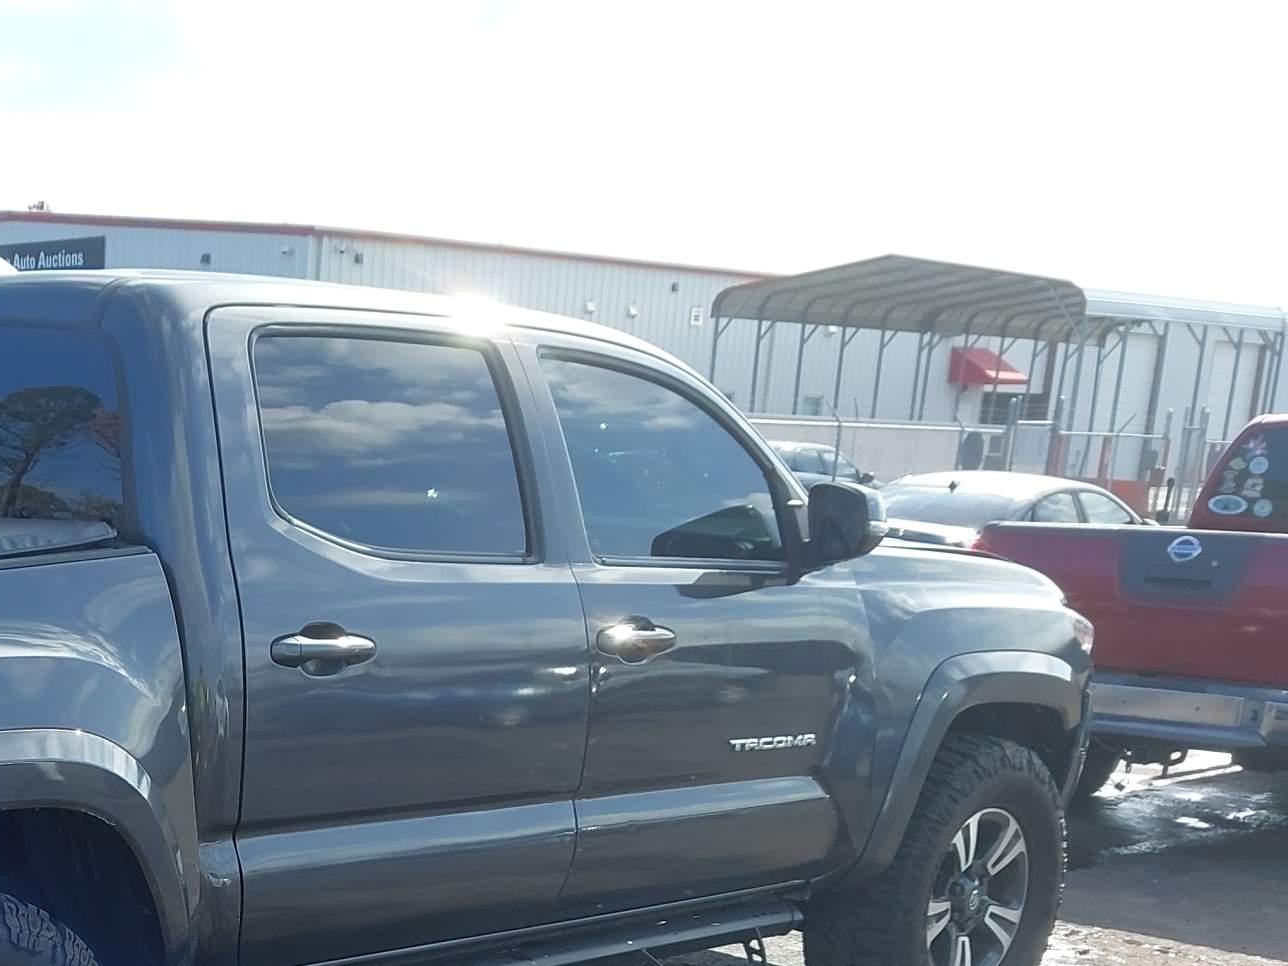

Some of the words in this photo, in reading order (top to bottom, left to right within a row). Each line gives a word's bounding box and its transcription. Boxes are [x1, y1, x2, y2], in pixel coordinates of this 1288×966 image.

[13, 253, 36, 270] Auto
[38, 249, 84, 269] Auctions
[728, 733, 817, 752] TACOMA
